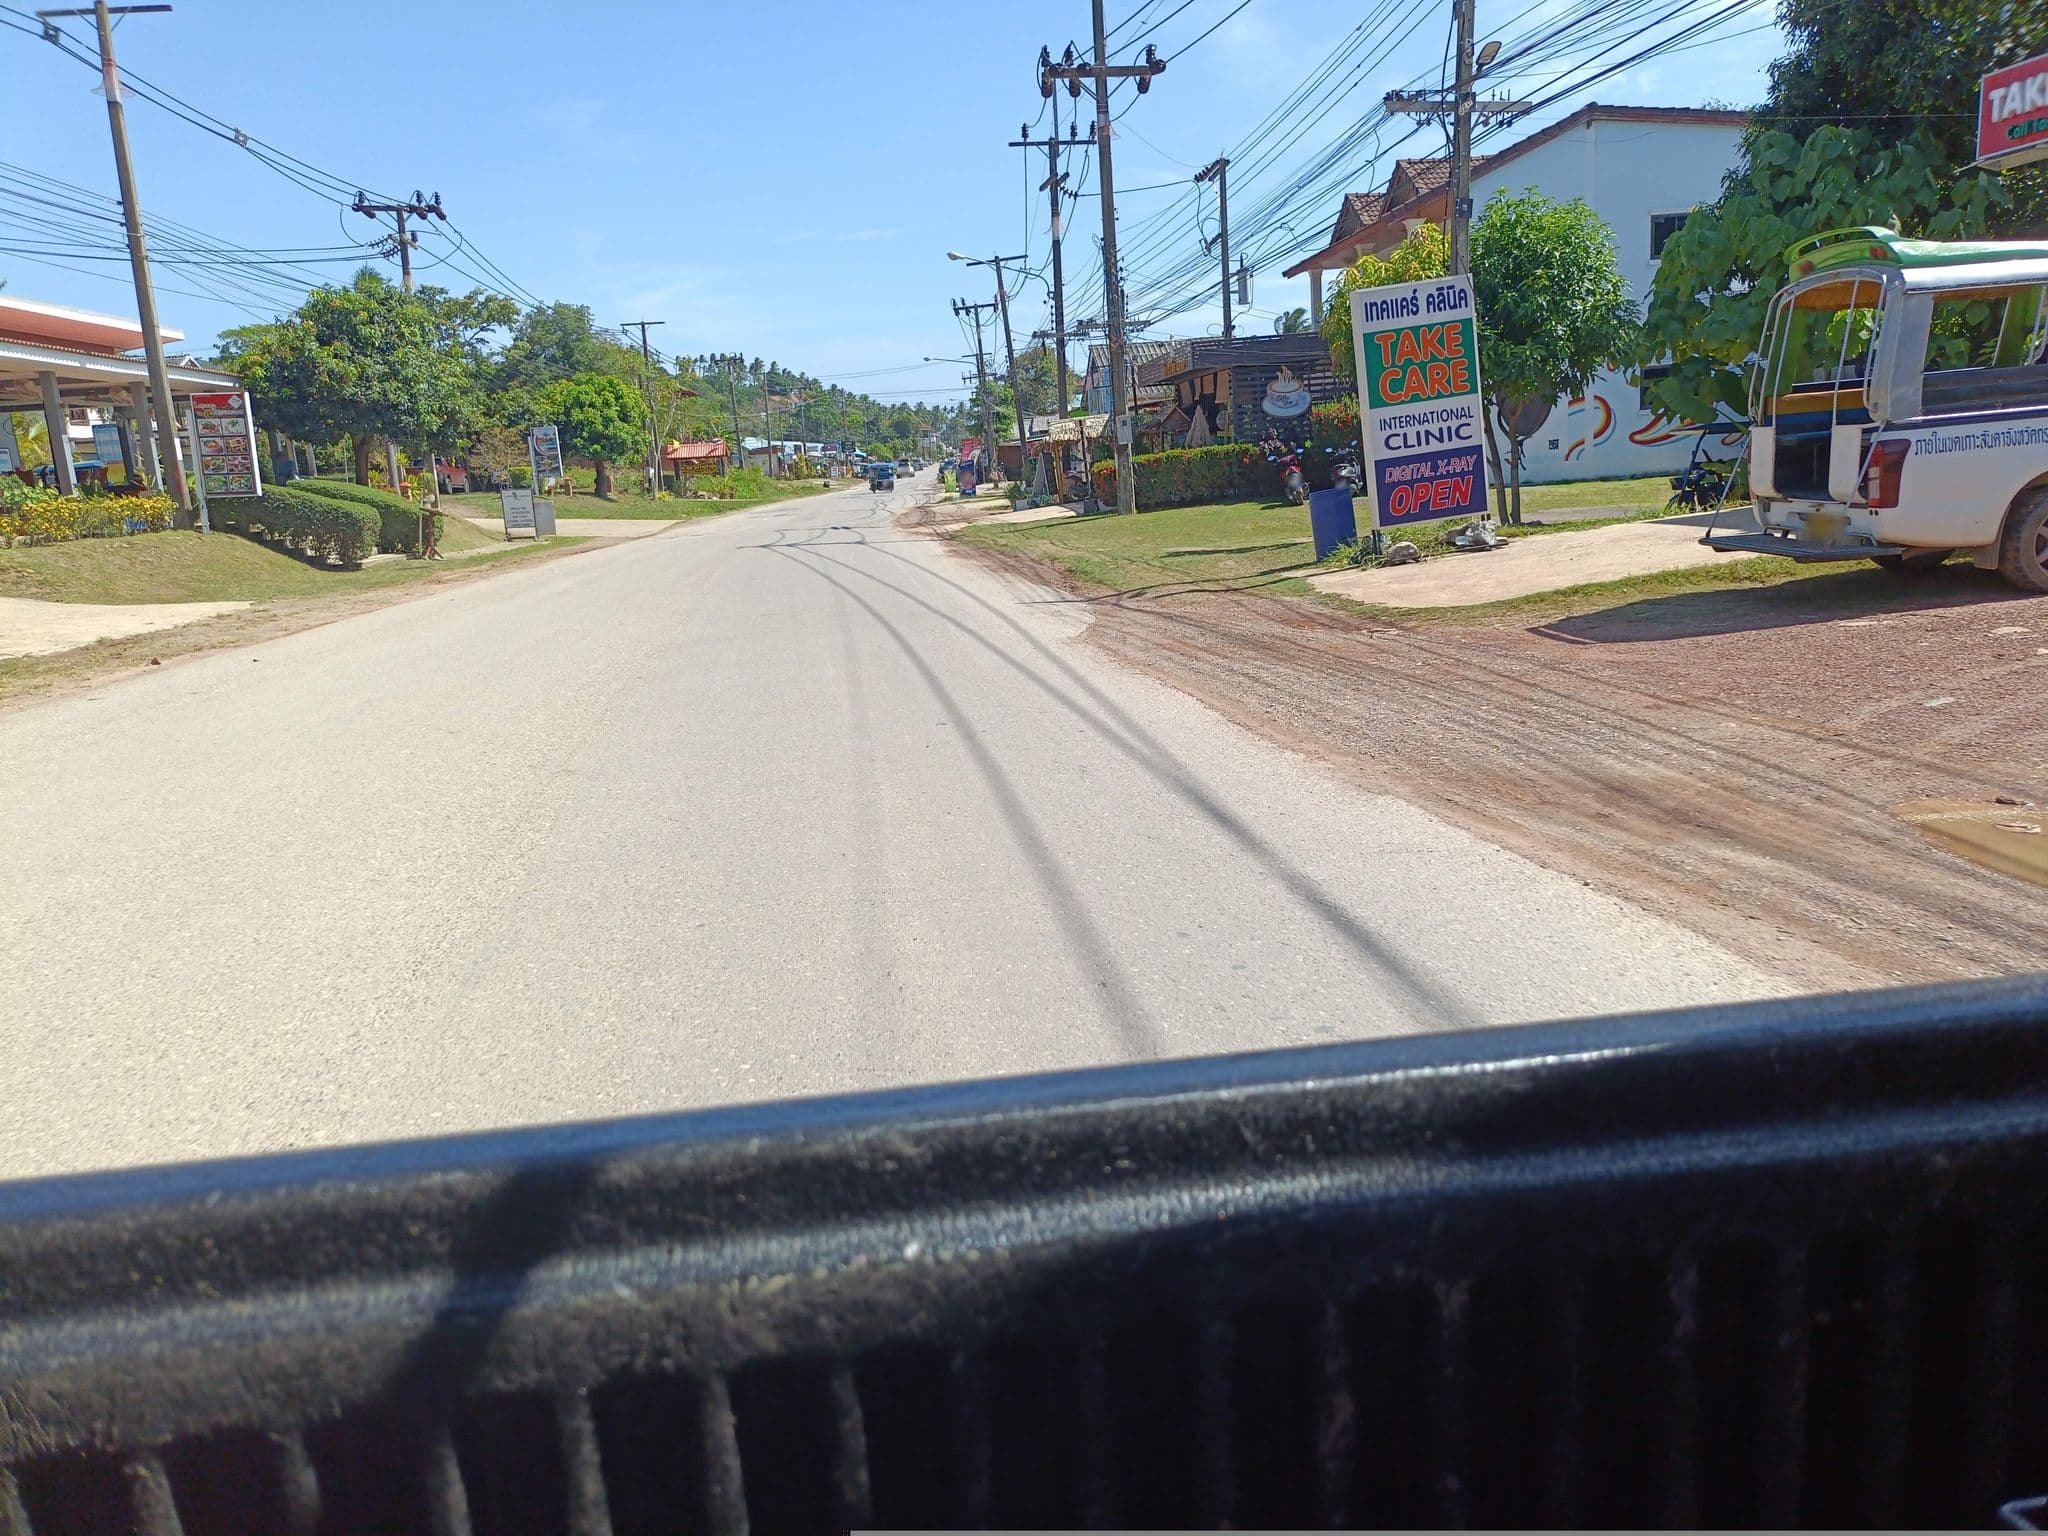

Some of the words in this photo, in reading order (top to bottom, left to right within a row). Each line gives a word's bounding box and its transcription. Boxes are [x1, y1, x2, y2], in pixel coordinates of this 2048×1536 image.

[1988, 72, 2048, 123] TAK
[1364, 288, 1420, 322] เทคแคร์
[1426, 285, 1468, 314] คลินิค
[1375, 322, 1464, 367] TAKE
[1379, 358, 1470, 404] CARE
[1379, 405, 1474, 432] INTERNATIONAL
[1384, 422, 1473, 451] CLINIC
[1385, 461, 1435, 484] DIGITAL
[1436, 454, 1478, 476] X-RAY
[1389, 475, 1473, 517] OPEN
